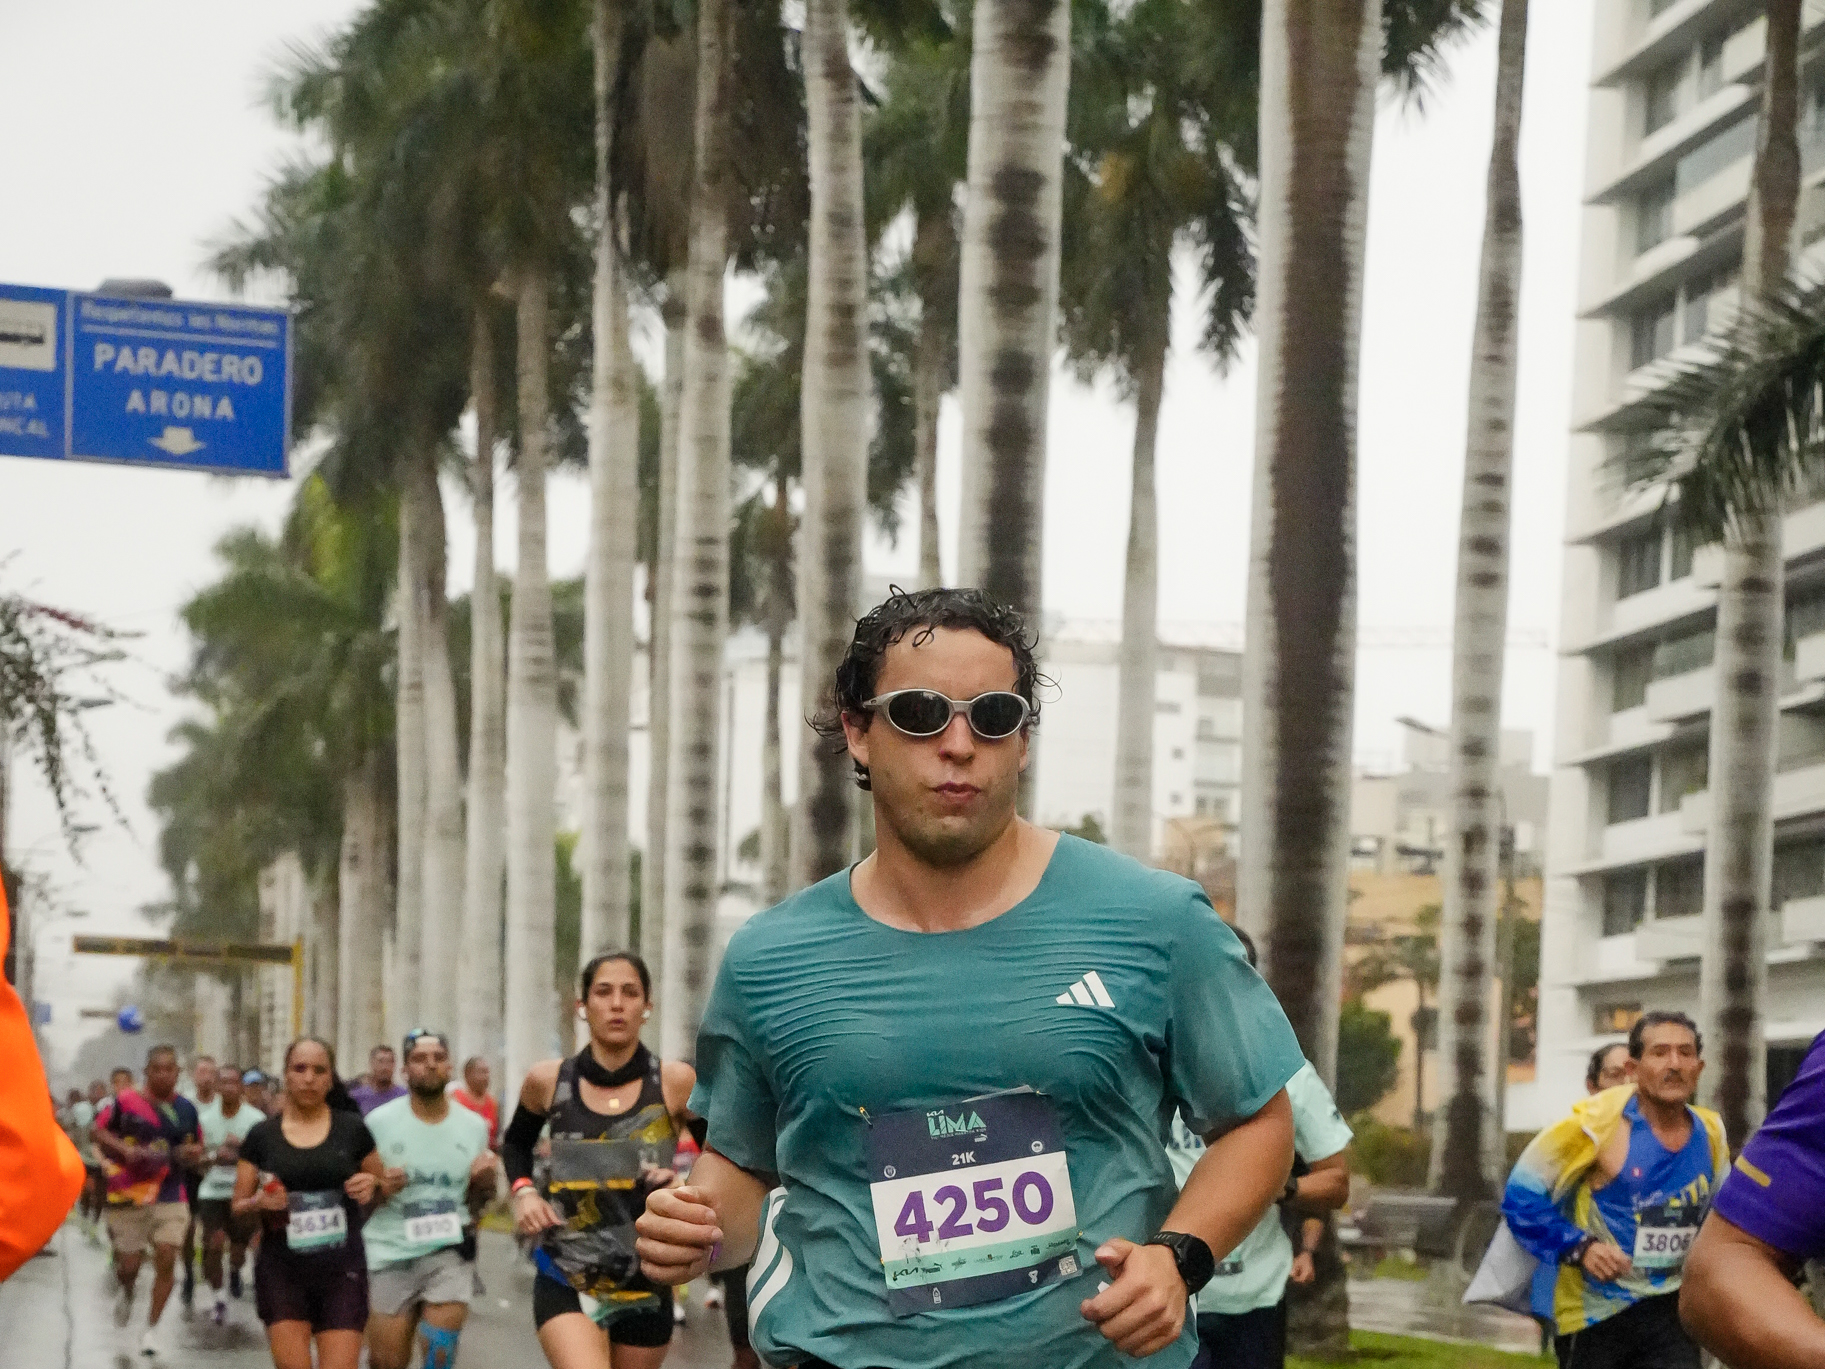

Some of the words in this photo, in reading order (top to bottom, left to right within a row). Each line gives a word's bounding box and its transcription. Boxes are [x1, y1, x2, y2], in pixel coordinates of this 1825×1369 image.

[93, 342, 264, 386] PARADERO
[125, 389, 235, 421] ARONA
[927, 1110, 987, 1137] LIMA
[951, 1151, 976, 1166] 21K
[893, 1171, 1054, 1243] 4250
